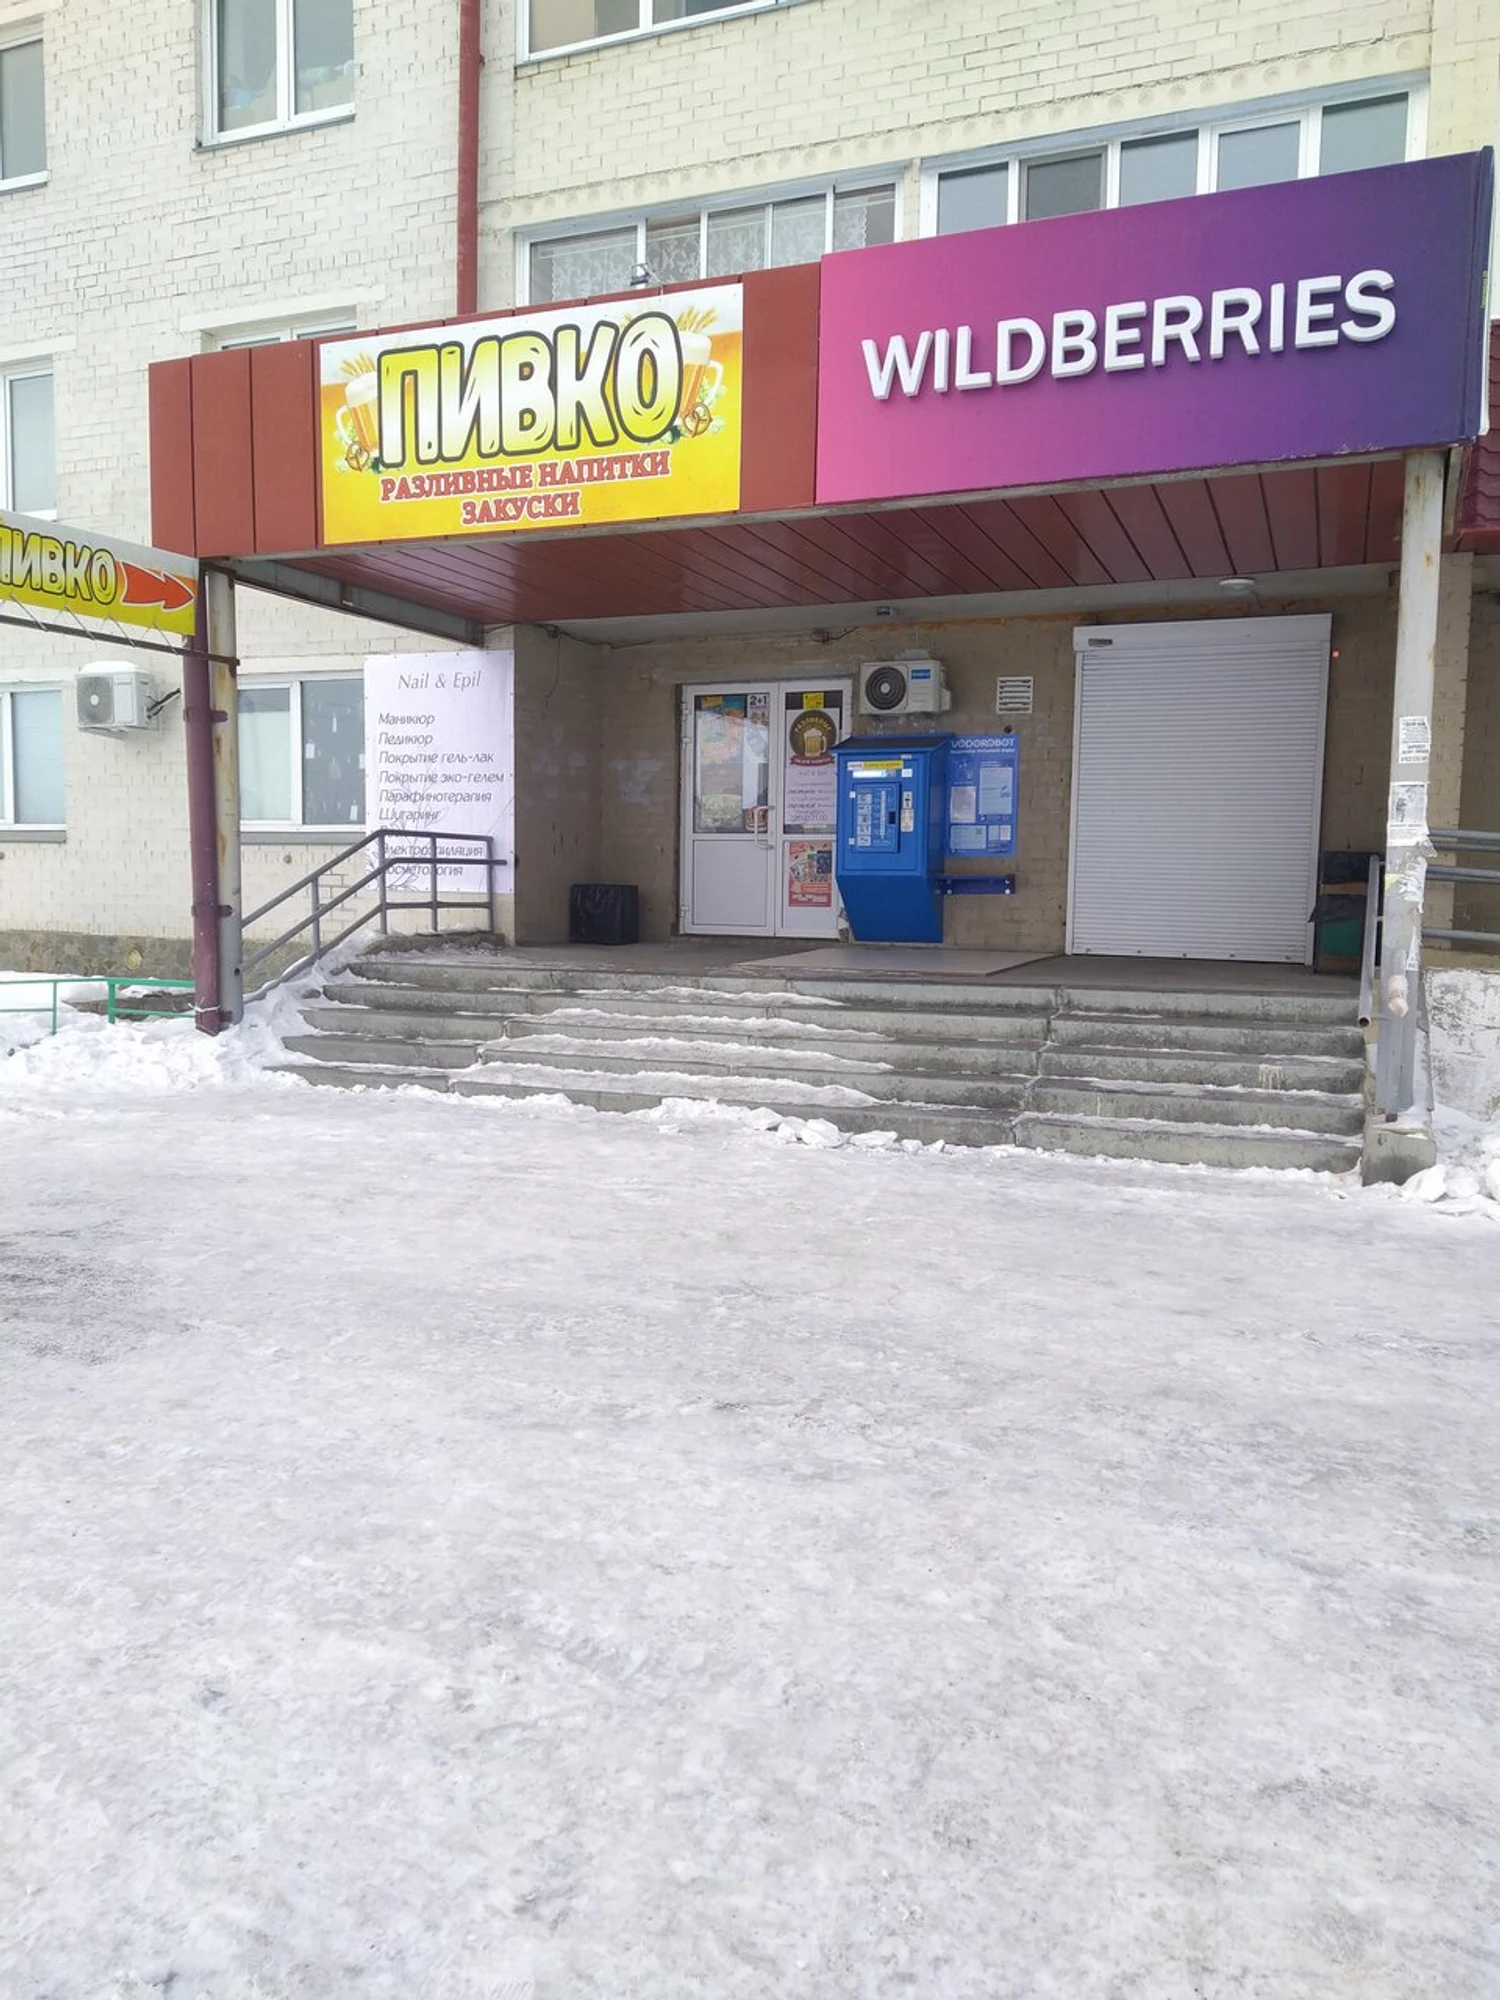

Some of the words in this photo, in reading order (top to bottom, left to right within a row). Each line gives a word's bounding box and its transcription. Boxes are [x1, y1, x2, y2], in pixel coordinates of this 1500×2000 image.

[861, 269, 1396, 400] WILDBERRIES
[378, 310, 684, 469] ПИВКО
[381, 464, 532, 501] РАЗЛИВНЫЕ
[539, 452, 670, 487] НАПИТКИ
[462, 492, 580, 525] ЗАКУСКИ
[398, 672, 430, 690] Nail
[434, 673, 447, 689] &
[453, 669, 482, 692] Epil
[378, 712, 436, 727] Маникюр
[378, 731, 434, 747] Педикюр
[379, 750, 439, 766] Покрытие
[441, 752, 495, 764] гель-лак
[379, 770, 439, 786] Покрытие
[440, 772, 505, 784] эко-гелем
[379, 789, 492, 805] Парафинотерапия
[379, 808, 441, 823] Шугаринг
